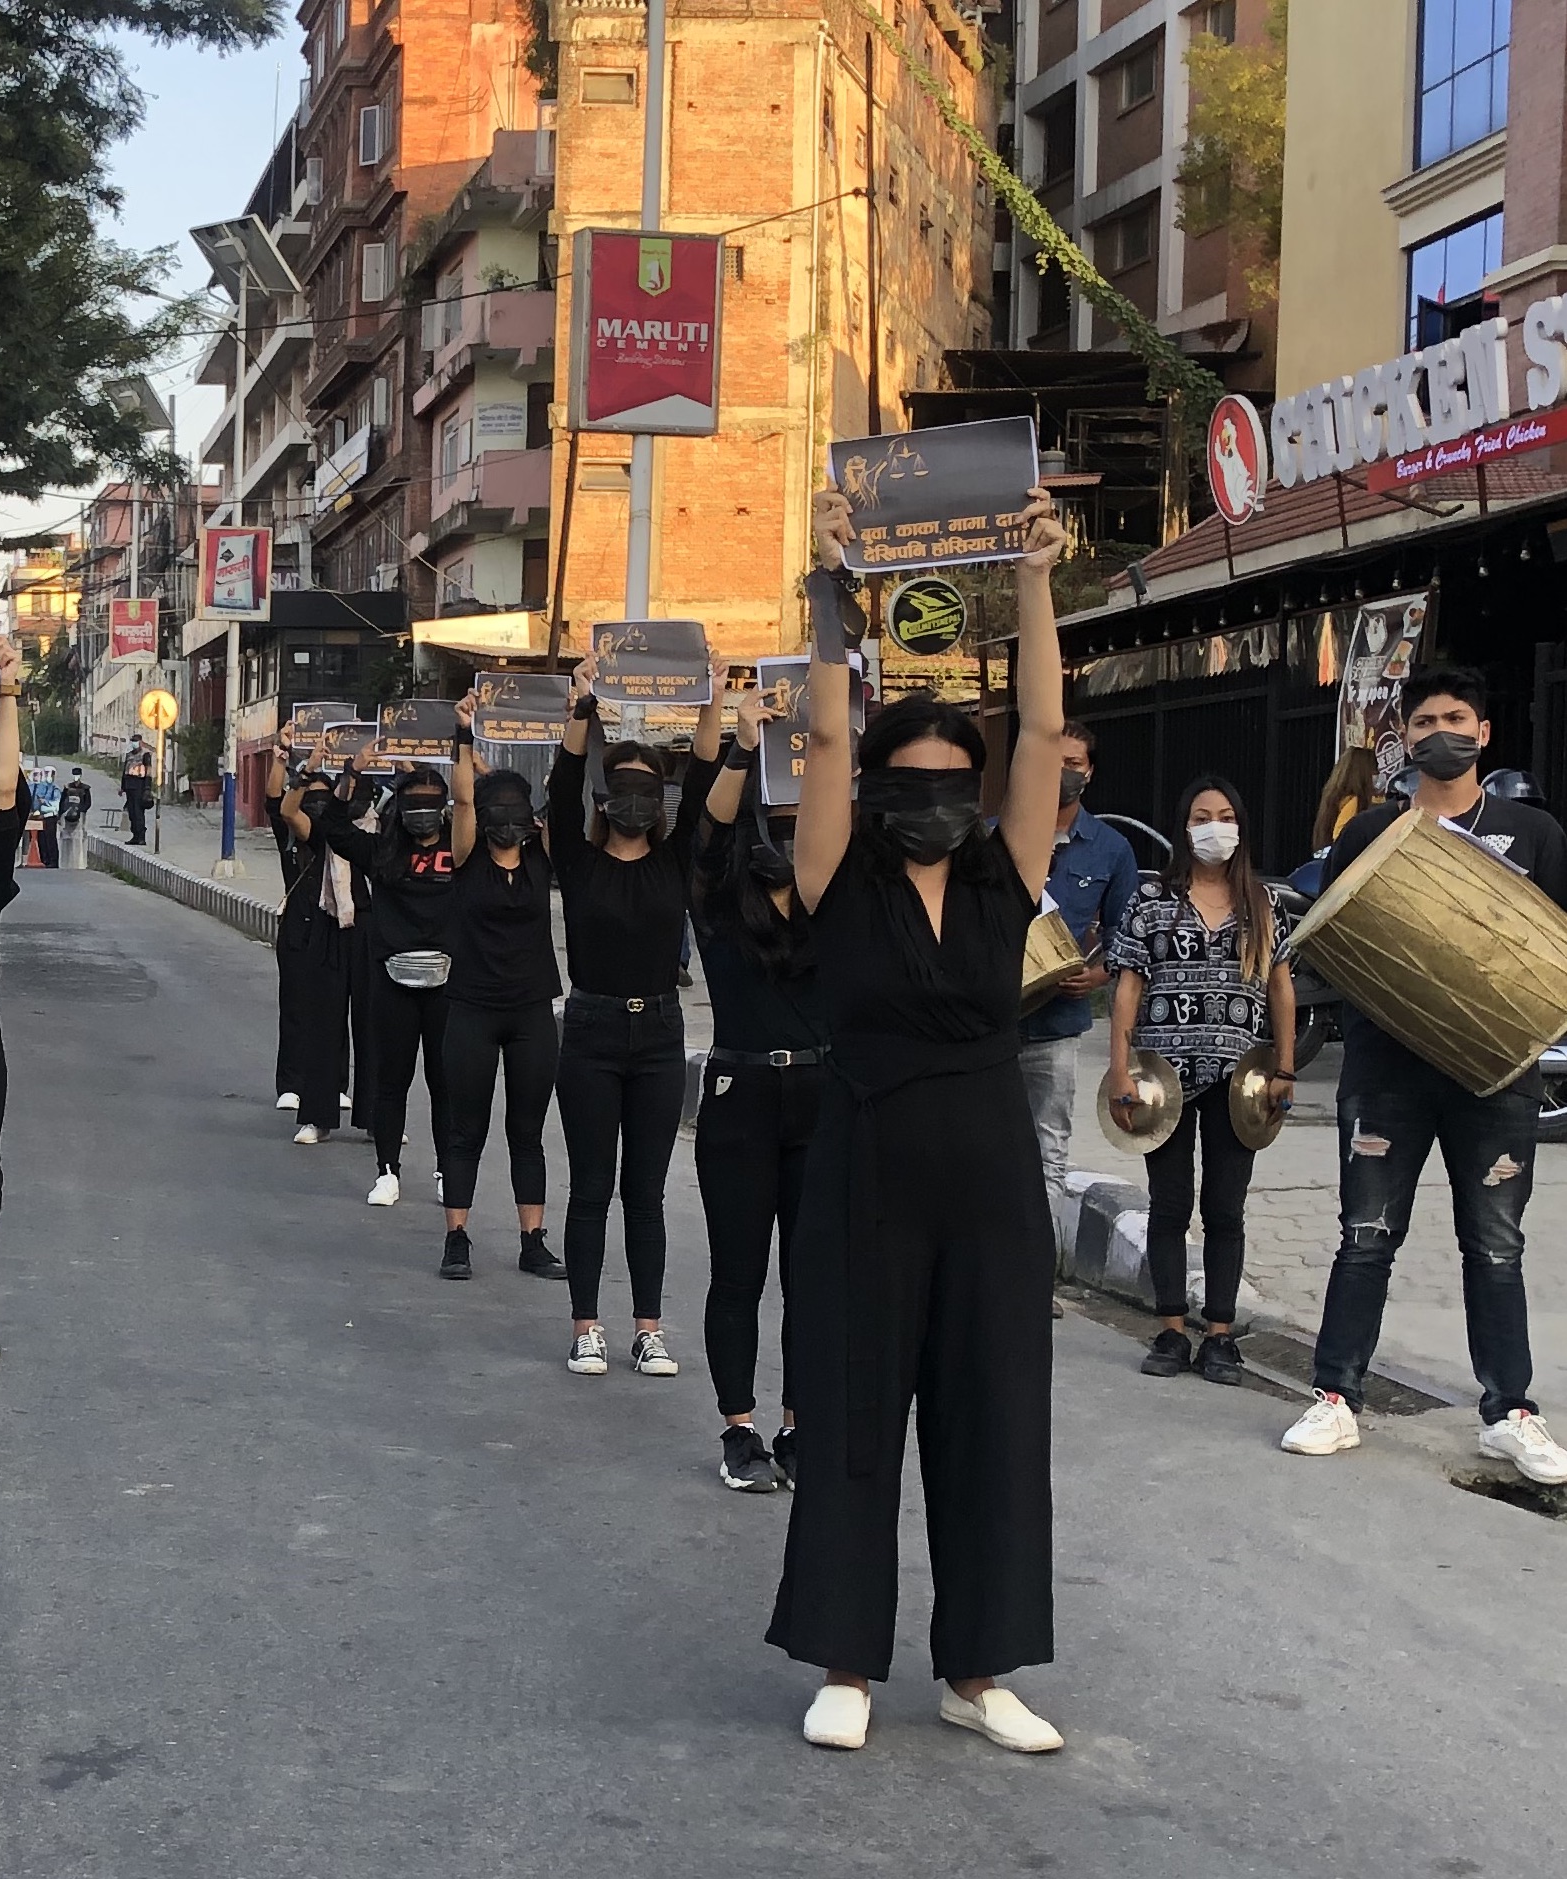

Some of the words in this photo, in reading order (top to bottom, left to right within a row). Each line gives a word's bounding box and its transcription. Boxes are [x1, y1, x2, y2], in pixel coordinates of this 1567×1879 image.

[597, 318, 709, 342] MARUTI
[596, 340, 708, 352] CEMENT
[1271, 316, 1510, 489] CHICKEN
[1506, 421, 1547, 450] Chicken
[605, 675, 619, 685] MY
[621, 675, 654, 685] DRESS
[656, 676, 698, 686] DOESN'T
